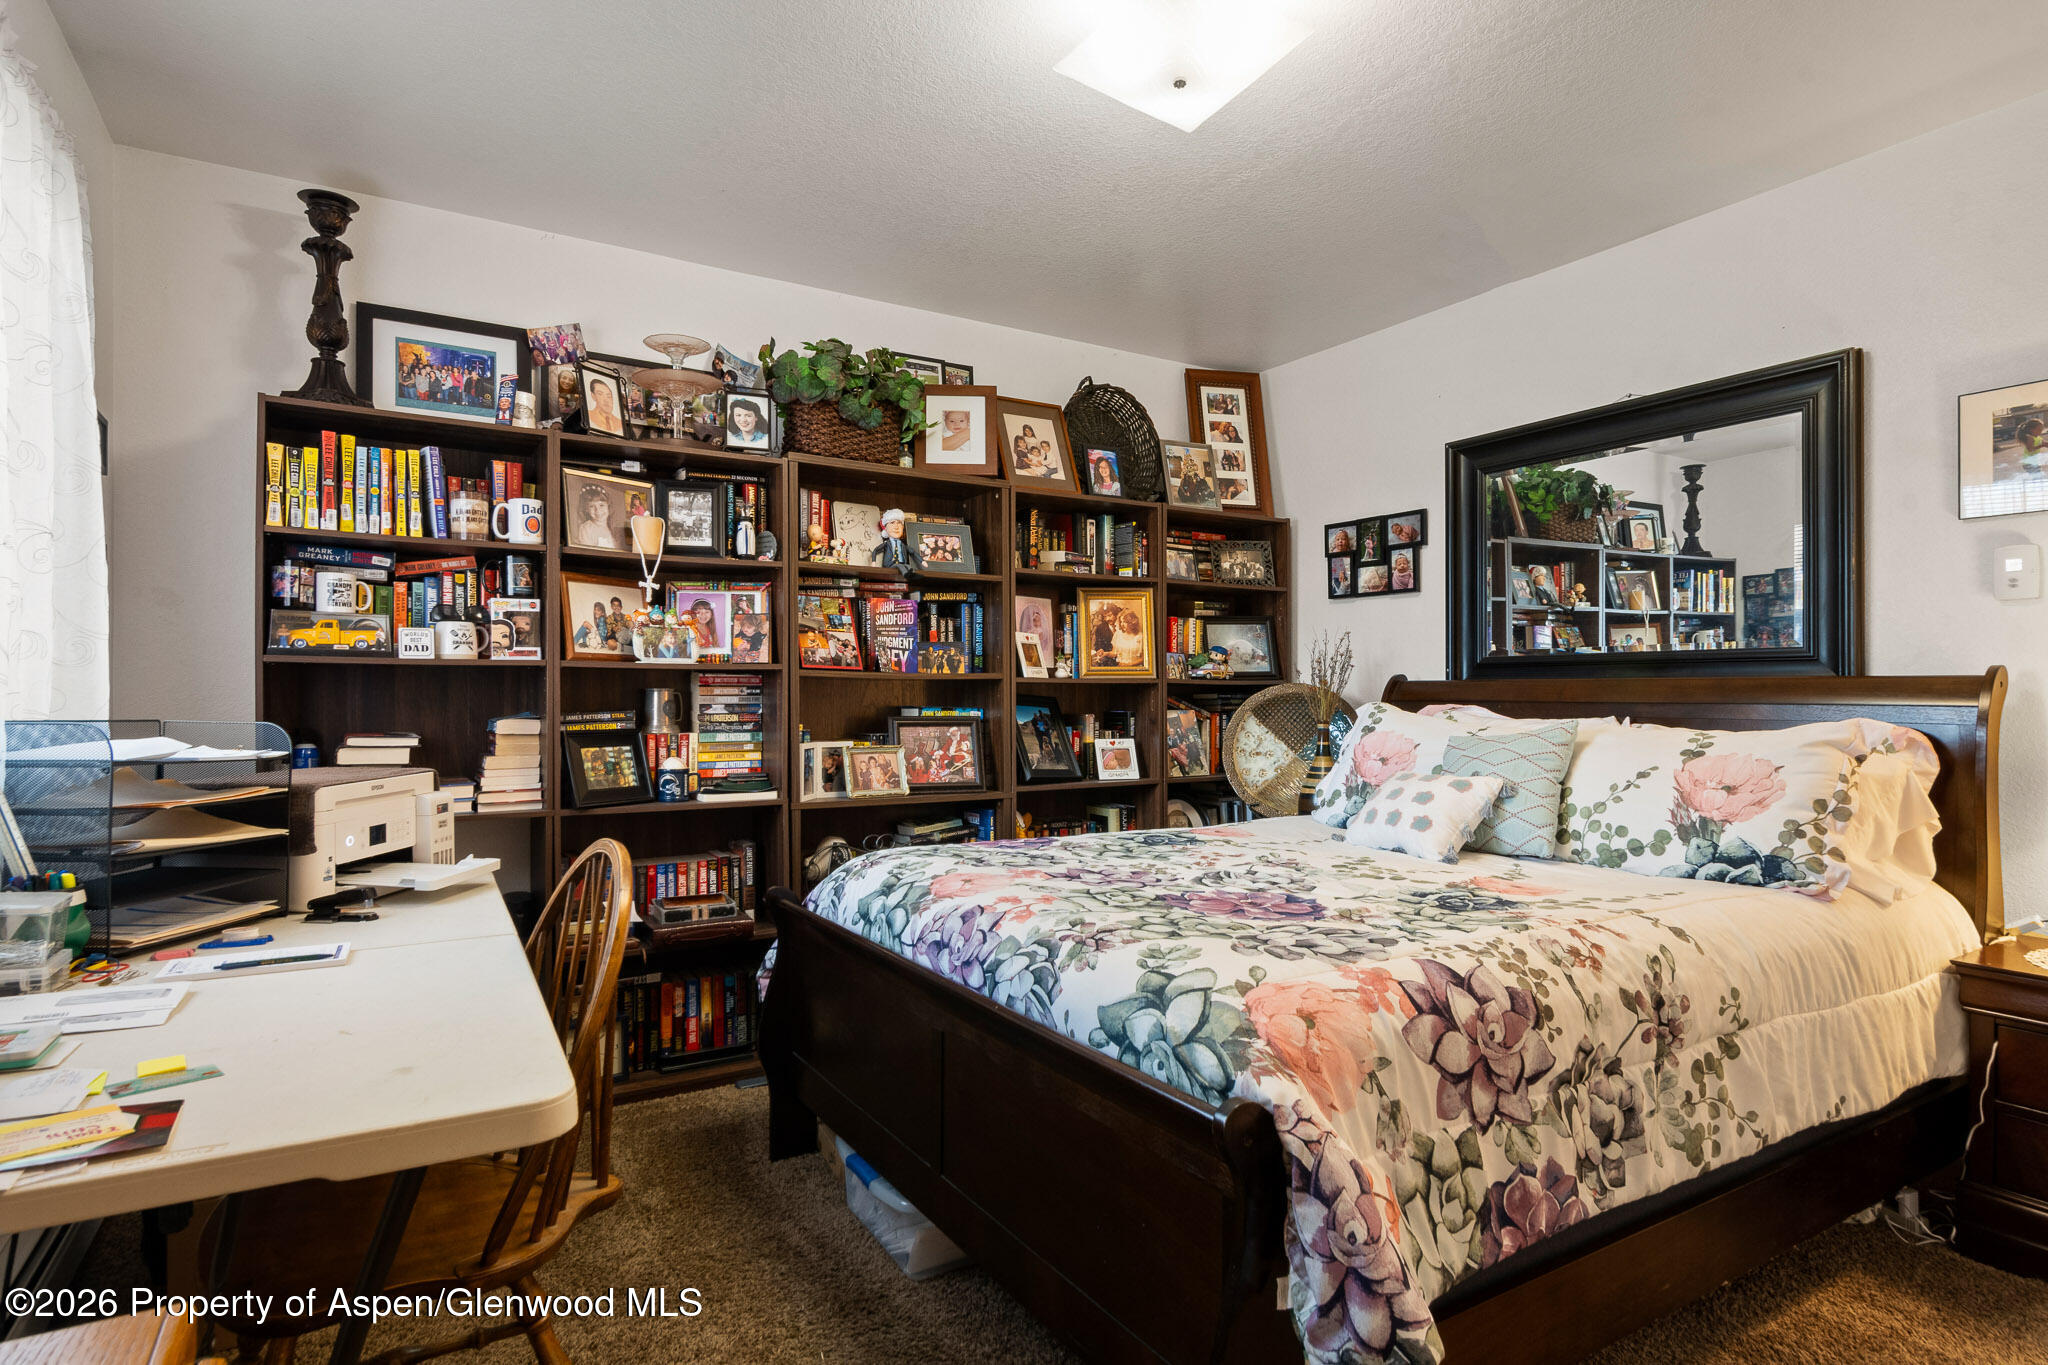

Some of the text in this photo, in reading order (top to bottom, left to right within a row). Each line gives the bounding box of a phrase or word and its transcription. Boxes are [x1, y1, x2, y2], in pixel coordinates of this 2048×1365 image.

[290, 463, 298, 472] LEE
[522, 504, 542, 514] Dad
[298, 552, 340, 562] GREANEY
[443, 576, 452, 592] JAMES
[428, 588, 437, 600] JAMES
[456, 586, 464, 597] JAMES
[876, 601, 895, 613] JOHN
[876, 613, 914, 625] SANDFORD
